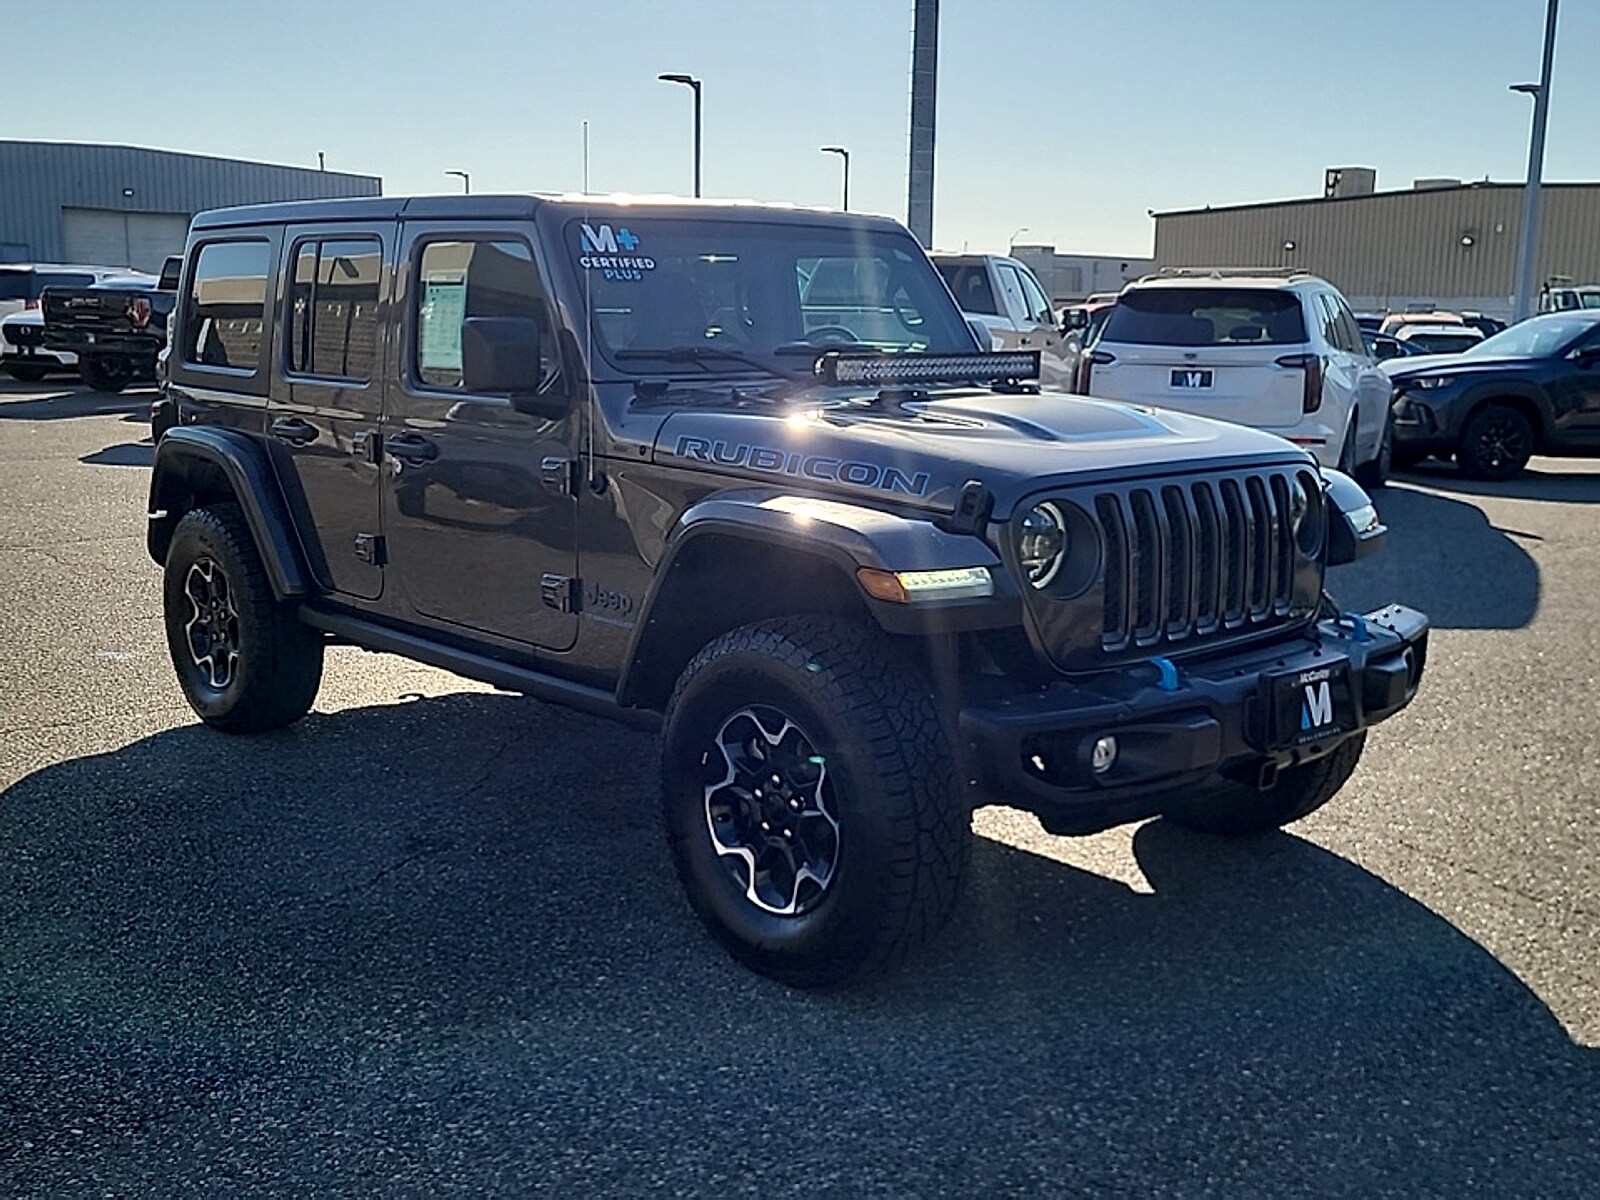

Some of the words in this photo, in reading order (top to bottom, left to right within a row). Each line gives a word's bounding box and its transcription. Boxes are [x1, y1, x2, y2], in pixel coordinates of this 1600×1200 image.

[579, 256, 655, 268] CERTIFIED
[604, 269, 642, 280] PLUS
[674, 435, 930, 498] RUBICON
[588, 582, 633, 616] Jeep
[1301, 681, 1333, 730] M
